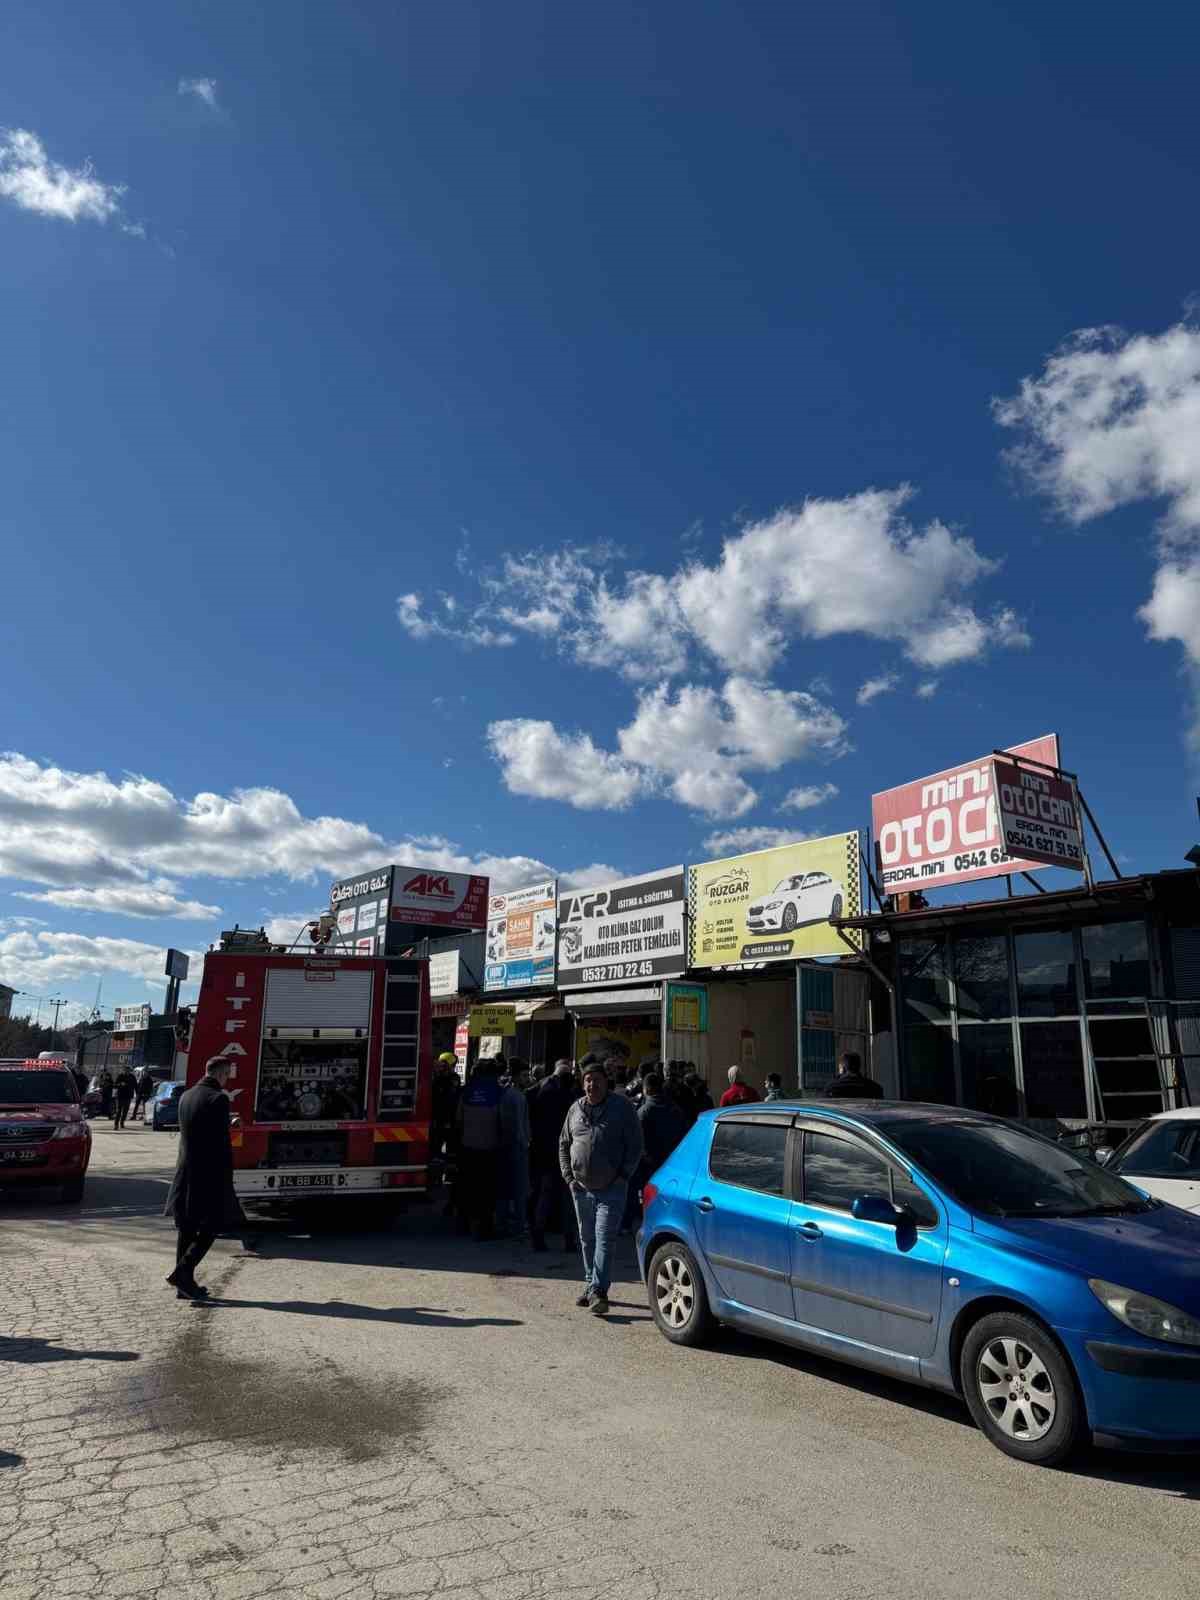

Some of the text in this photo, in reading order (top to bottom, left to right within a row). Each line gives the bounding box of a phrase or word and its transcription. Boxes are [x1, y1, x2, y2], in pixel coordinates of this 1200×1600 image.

[921, 765, 990, 808] mini
[1015, 818, 1048, 835] ERDAL
[1006, 830, 1080, 858] 0542 627 51 52
[882, 868, 920, 883] ERDAL
[954, 850, 987, 870] 0542
[353, 881, 369, 896] OTO
[369, 875, 388, 890] GAZ
[643, 889, 673, 904] SOĞUTMA
[598, 915, 664, 939] OTO KLİMA GAZ DOLUM
[583, 928, 681, 960] KALORİFER PETEK TEMİZLİĞİ
[582, 960, 653, 982] 0532 770 22 45
